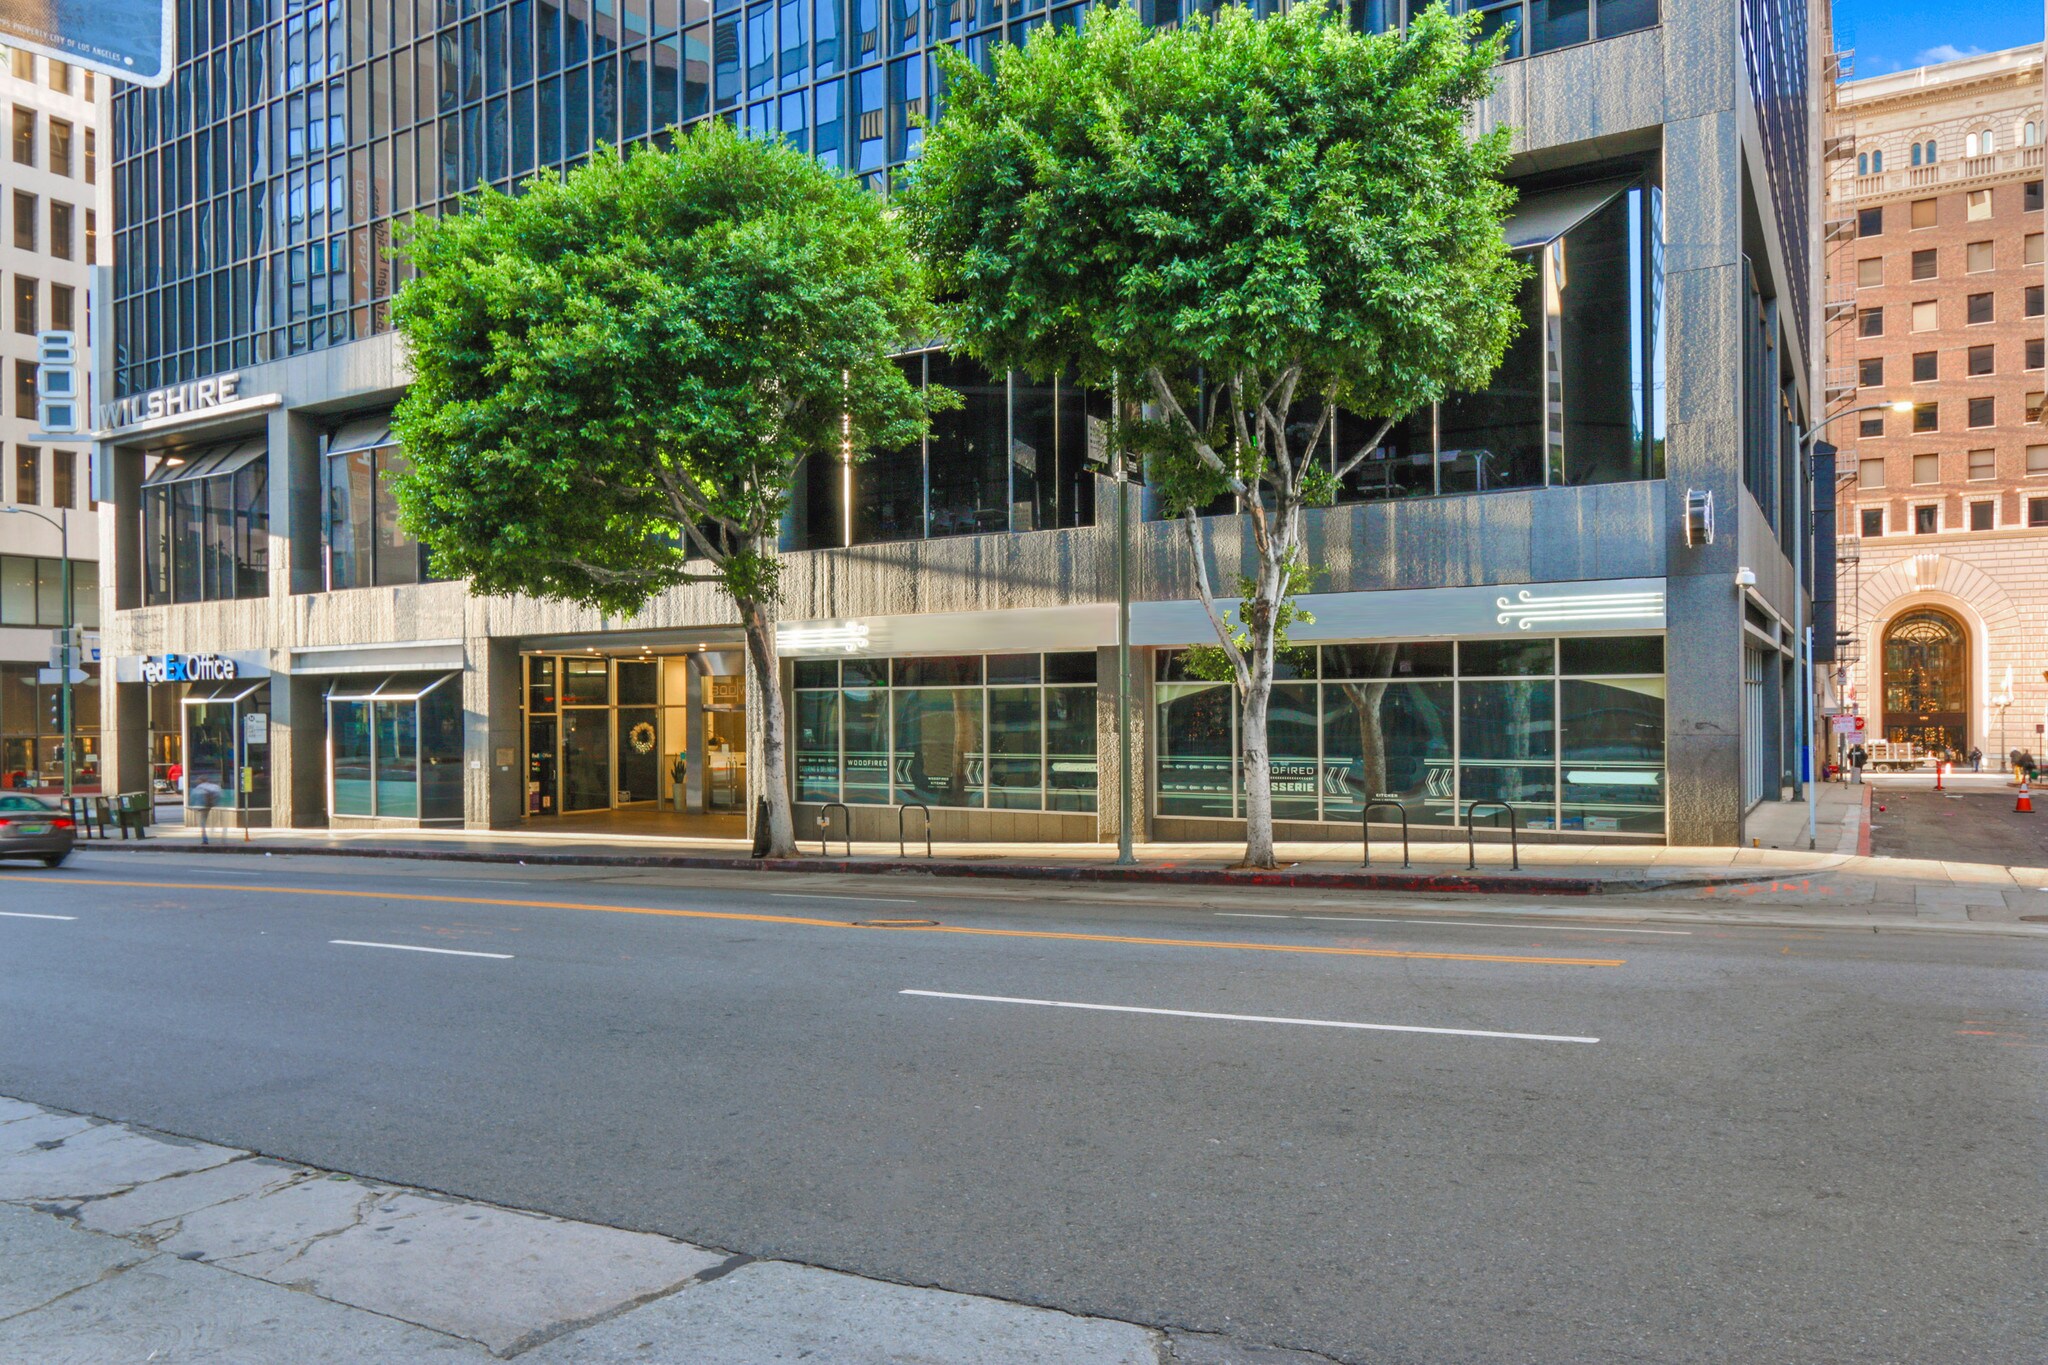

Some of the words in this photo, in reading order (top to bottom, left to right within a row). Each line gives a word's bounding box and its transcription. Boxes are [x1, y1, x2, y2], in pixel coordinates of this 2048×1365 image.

[49, 33, 65, 43] CITY
[67, 39, 75, 47] OF
[78, 42, 90, 52] LOS
[93, 47, 120, 61] ANGELES
[100, 372, 239, 430] WILSHIRE
[139, 653, 186, 683] FedEx
[186, 653, 234, 681] Office
[1244, 783, 1314, 792] SSERIE
